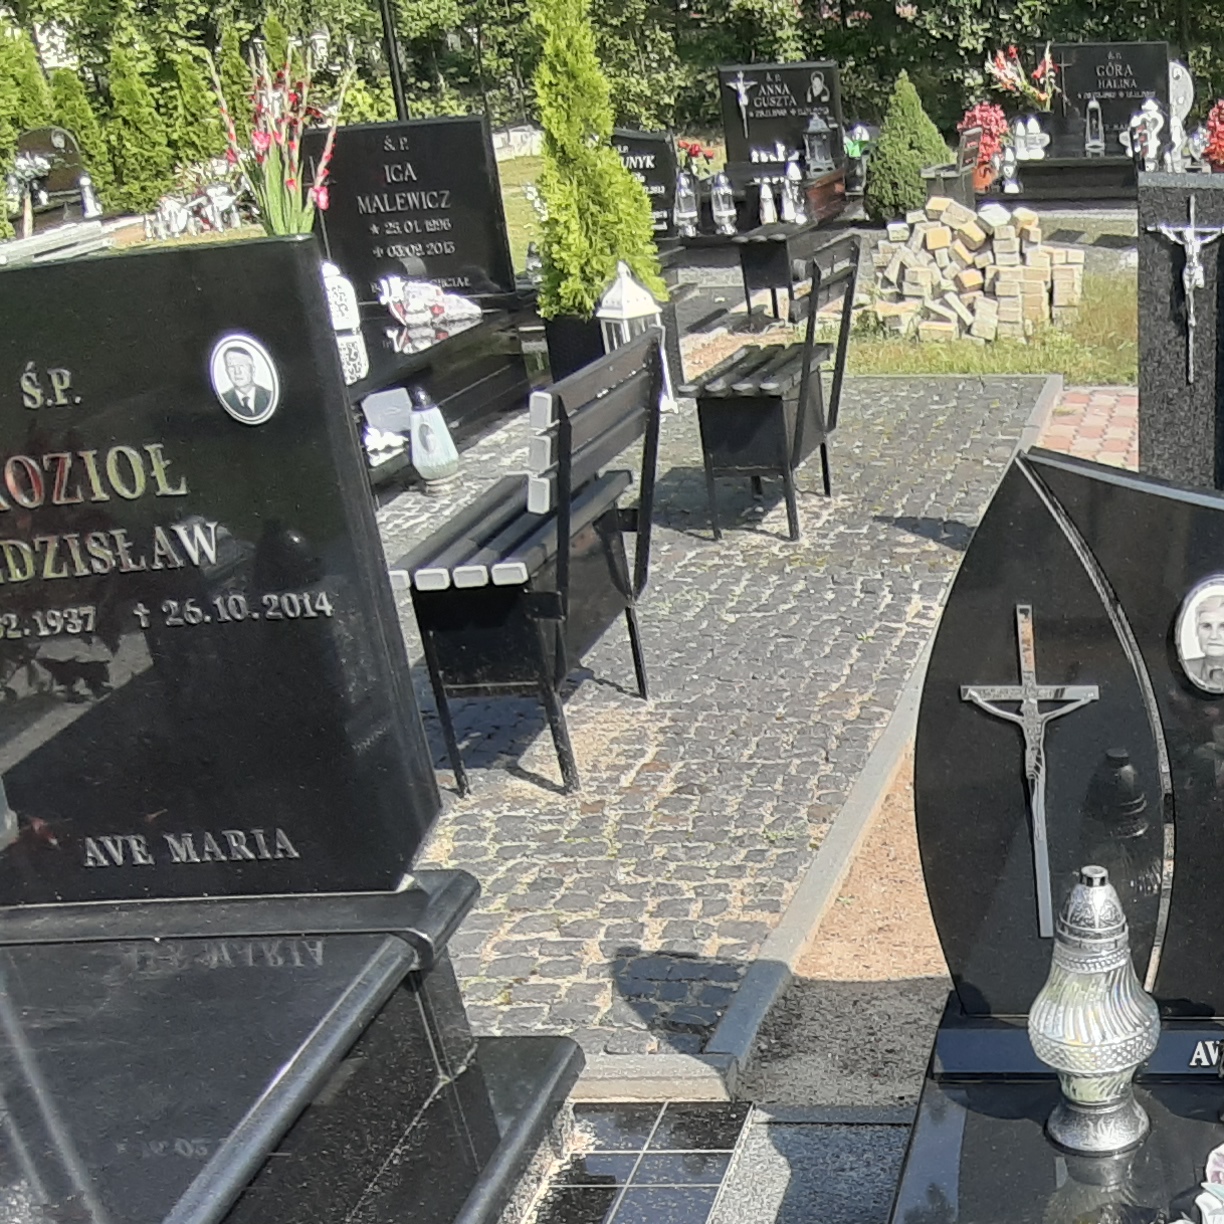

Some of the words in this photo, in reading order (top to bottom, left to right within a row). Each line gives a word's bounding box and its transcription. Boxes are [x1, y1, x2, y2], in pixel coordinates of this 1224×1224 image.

[1096, 62, 1133, 77] GÓRA
[759, 83, 790, 96] ANNA
[1098, 79, 1137, 89] HALINA
[384, 163, 417, 183] IGA
[357, 190, 451, 215] MALEWICZ
[20, 362, 81, 409] Ś.P.
[0, 443, 187, 511] OZIOŁ
[0, 521, 218, 584] DZISŁAW
[0, 606, 96, 640] 2.1937
[162, 592, 334, 626] 26.10.2014
[83, 834, 155, 868] AVE
[164, 827, 300, 863] MARIA
[1189, 1041, 1219, 1066] AV
